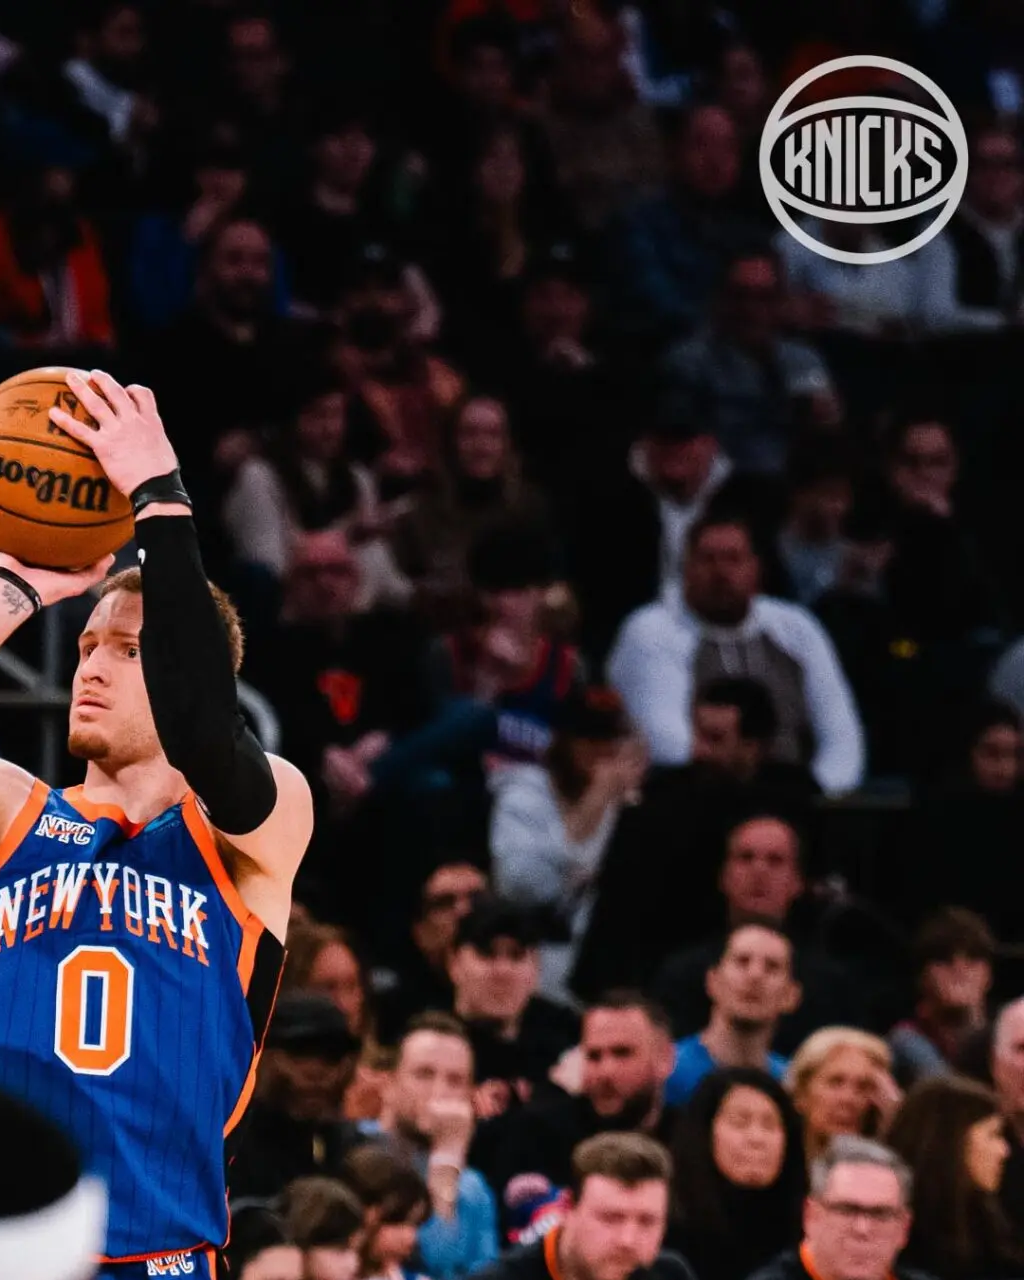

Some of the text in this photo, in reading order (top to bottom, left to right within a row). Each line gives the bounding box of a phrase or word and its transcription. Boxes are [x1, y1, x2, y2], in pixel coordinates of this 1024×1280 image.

[35, 813, 95, 846] NYC
[92, 862, 210, 967] YORK
[54, 945, 134, 1076] 0
